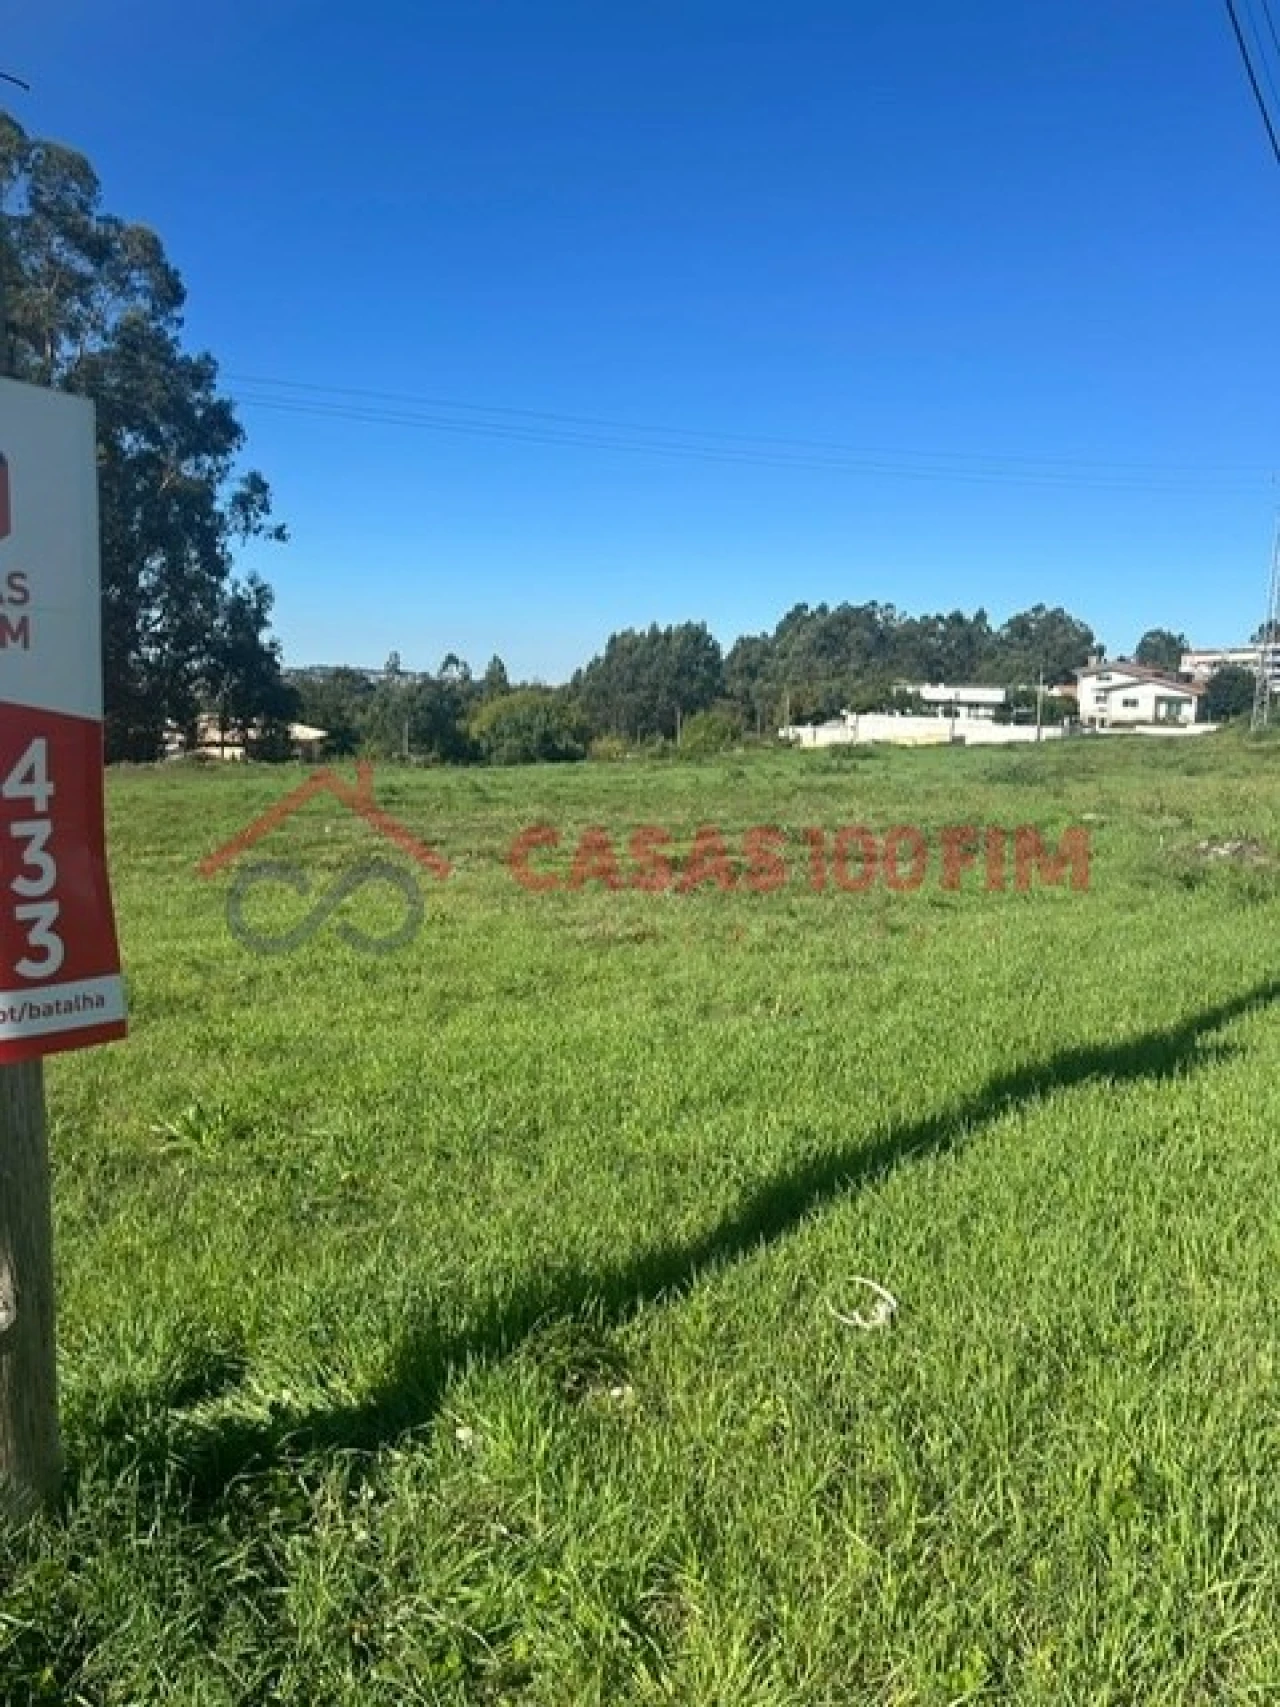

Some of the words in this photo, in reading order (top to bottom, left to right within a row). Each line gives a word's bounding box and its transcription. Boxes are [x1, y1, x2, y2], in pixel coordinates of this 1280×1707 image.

[0, 571, 30, 606] S
[2, 736, 54, 812] 4
[10, 819, 57, 897] 3
[14, 900, 64, 979] 3
